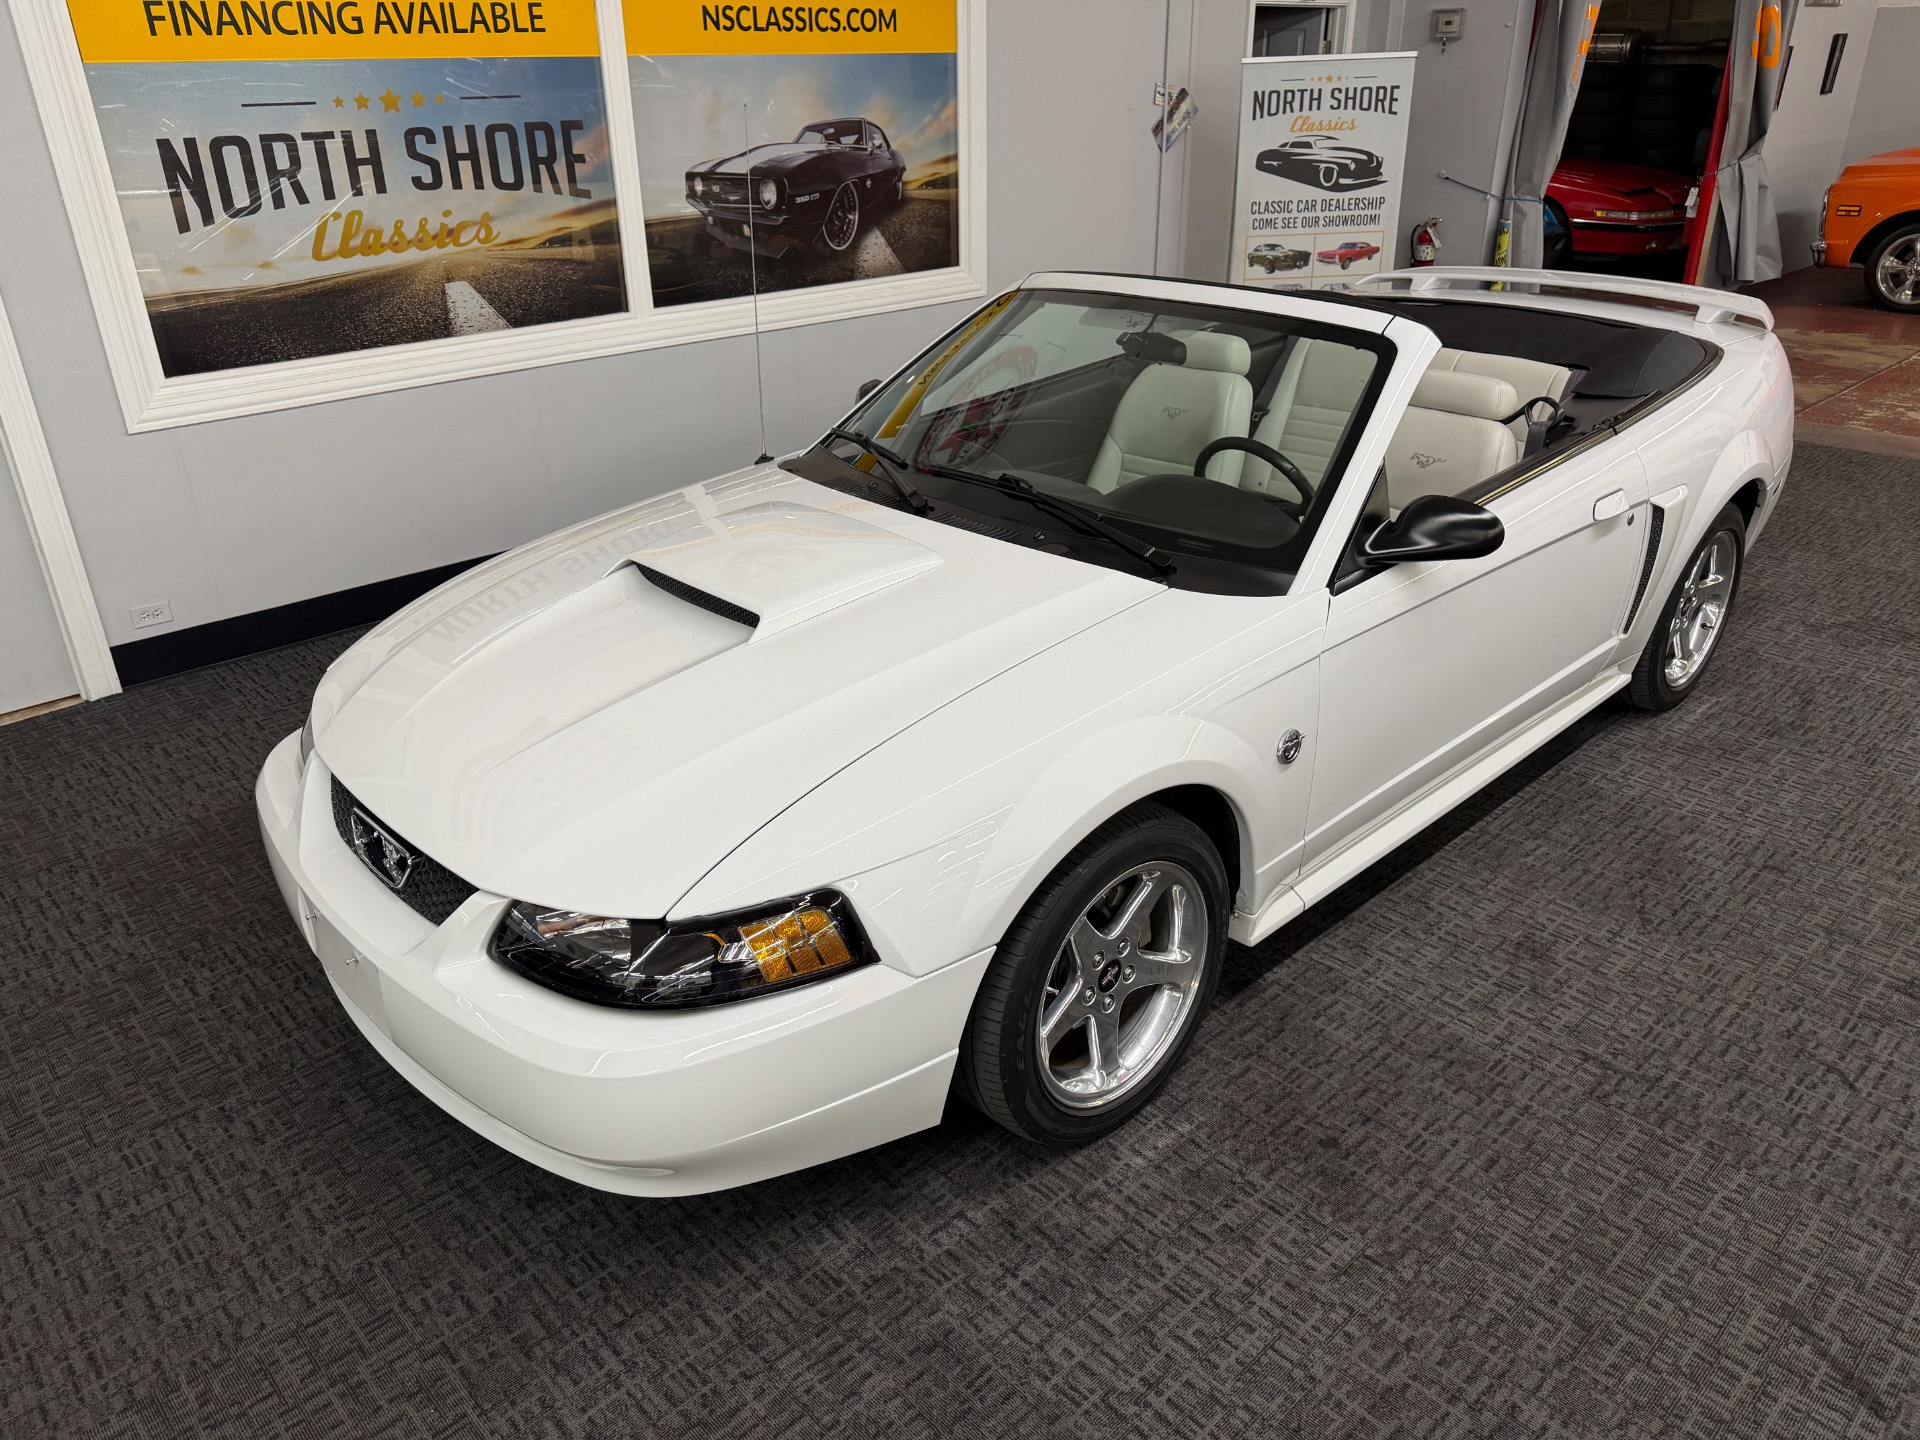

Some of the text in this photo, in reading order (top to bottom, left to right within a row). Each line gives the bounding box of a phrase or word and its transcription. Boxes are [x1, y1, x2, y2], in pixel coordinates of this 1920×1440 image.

[144, 0, 547, 37] FINANCING AVAILABLE
[701, 4, 898, 33] NSCLASSICS.COM
[1252, 85, 1401, 121] NORTH SHORE
[1289, 115, 1358, 133] Classics
[155, 119, 593, 235] NORTH SHORE
[1250, 196, 1386, 215] CLASSIC CAR DEALERSHIP
[311, 208, 501, 262] Classics
[1251, 213, 1381, 231] COME SEE OUR SHOWROOM!
